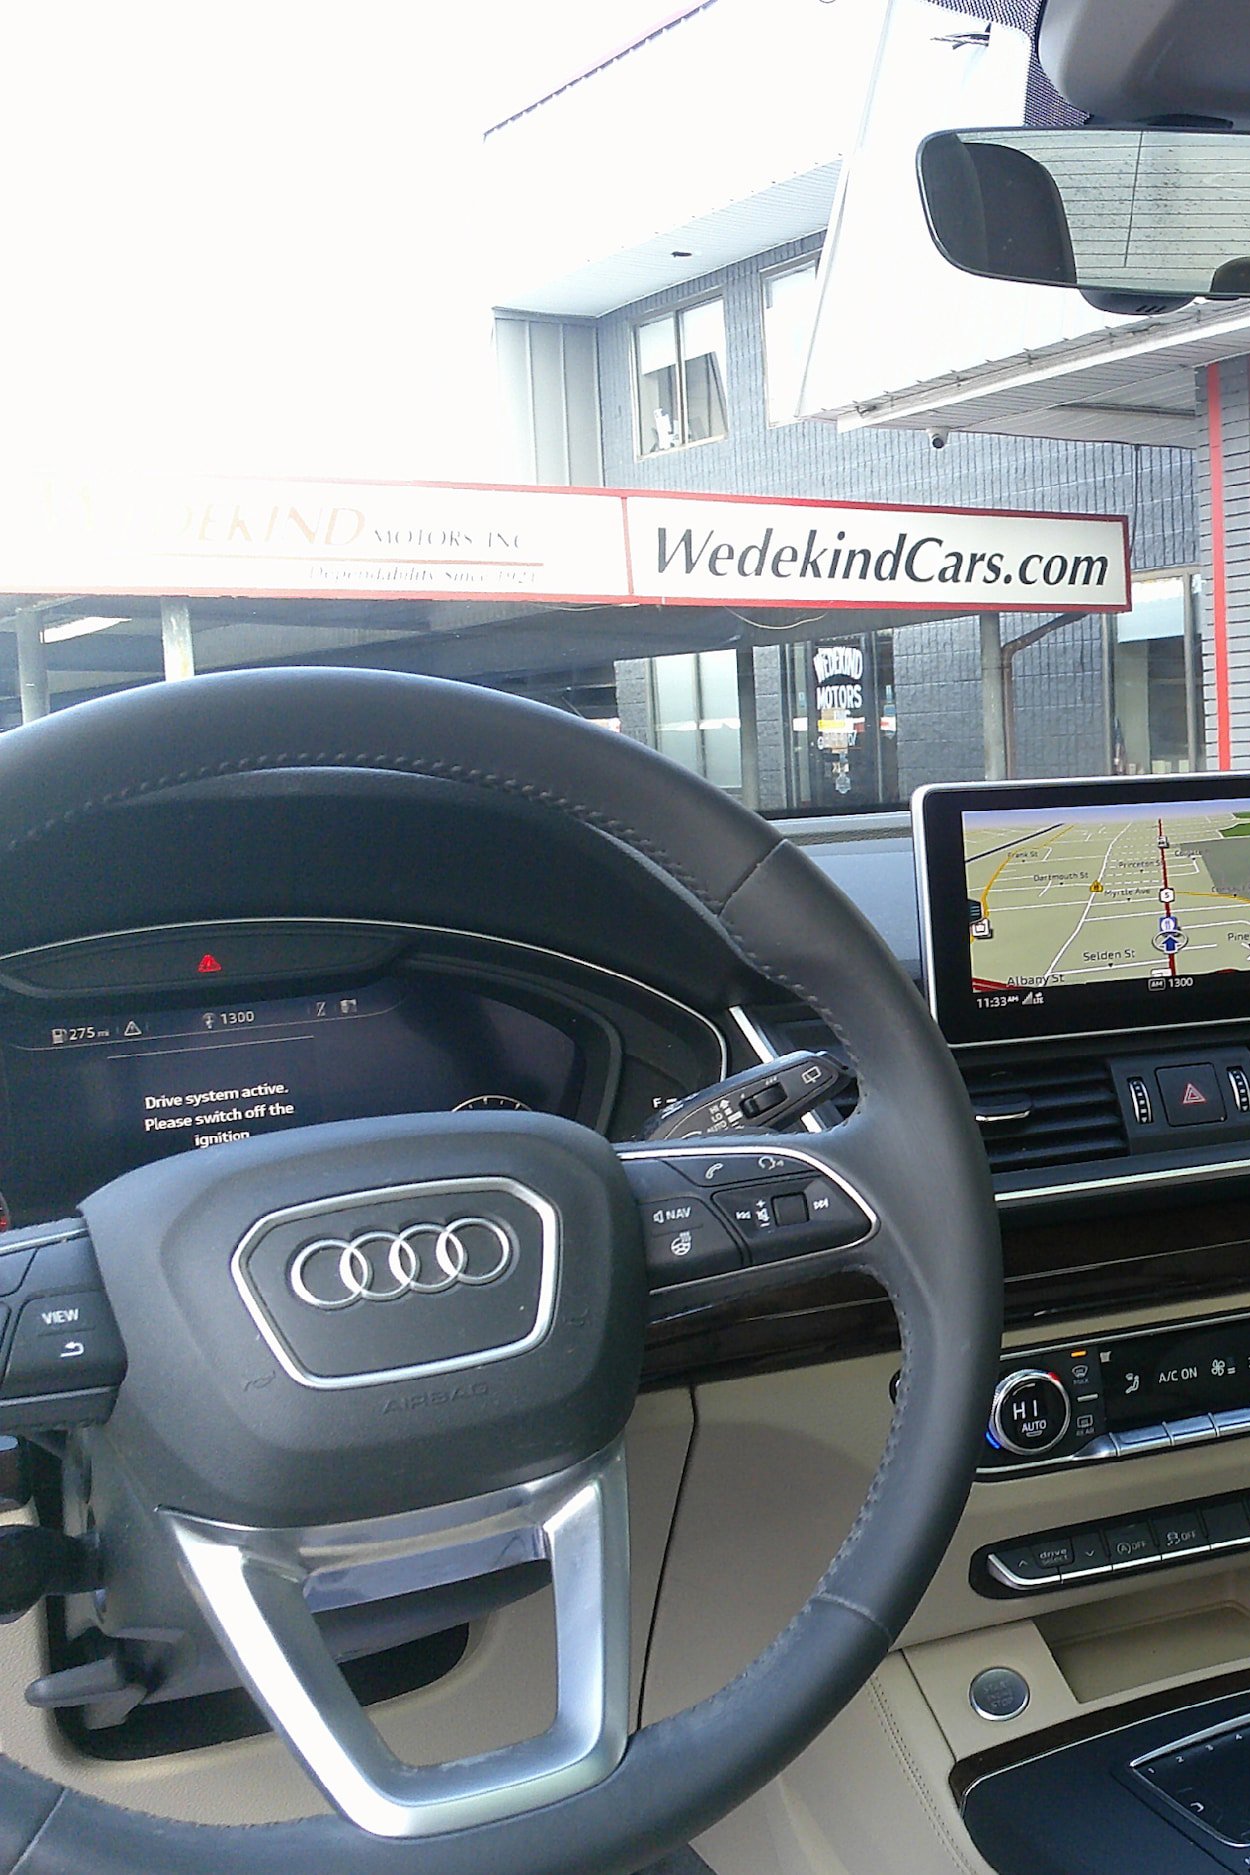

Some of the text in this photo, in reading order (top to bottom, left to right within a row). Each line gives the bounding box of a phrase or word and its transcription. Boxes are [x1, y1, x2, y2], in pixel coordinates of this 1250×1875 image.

[656, 526, 1109, 586] WedekindCars.com
[813, 647, 863, 683] WEDEKIND
[817, 685, 862, 710] MOTORS
[1227, 933, 1249, 942] Pine
[1083, 948, 1135, 962] Selden St
[1006, 973, 1065, 988] Albany St
[1168, 977, 1194, 988] 1300
[219, 1010, 255, 1025] 1300
[69, 1027, 95, 1042] 275
[144, 1081, 289, 1111] Drive system active.
[144, 1102, 295, 1133] Please switch off the
[194, 1131, 250, 1148] ignition
[665, 1206, 691, 1220] NAV
[41, 1308, 79, 1325] VIEW
[1158, 1367, 1198, 1383] A/C ON
[1022, 1419, 1047, 1433] AUTO
